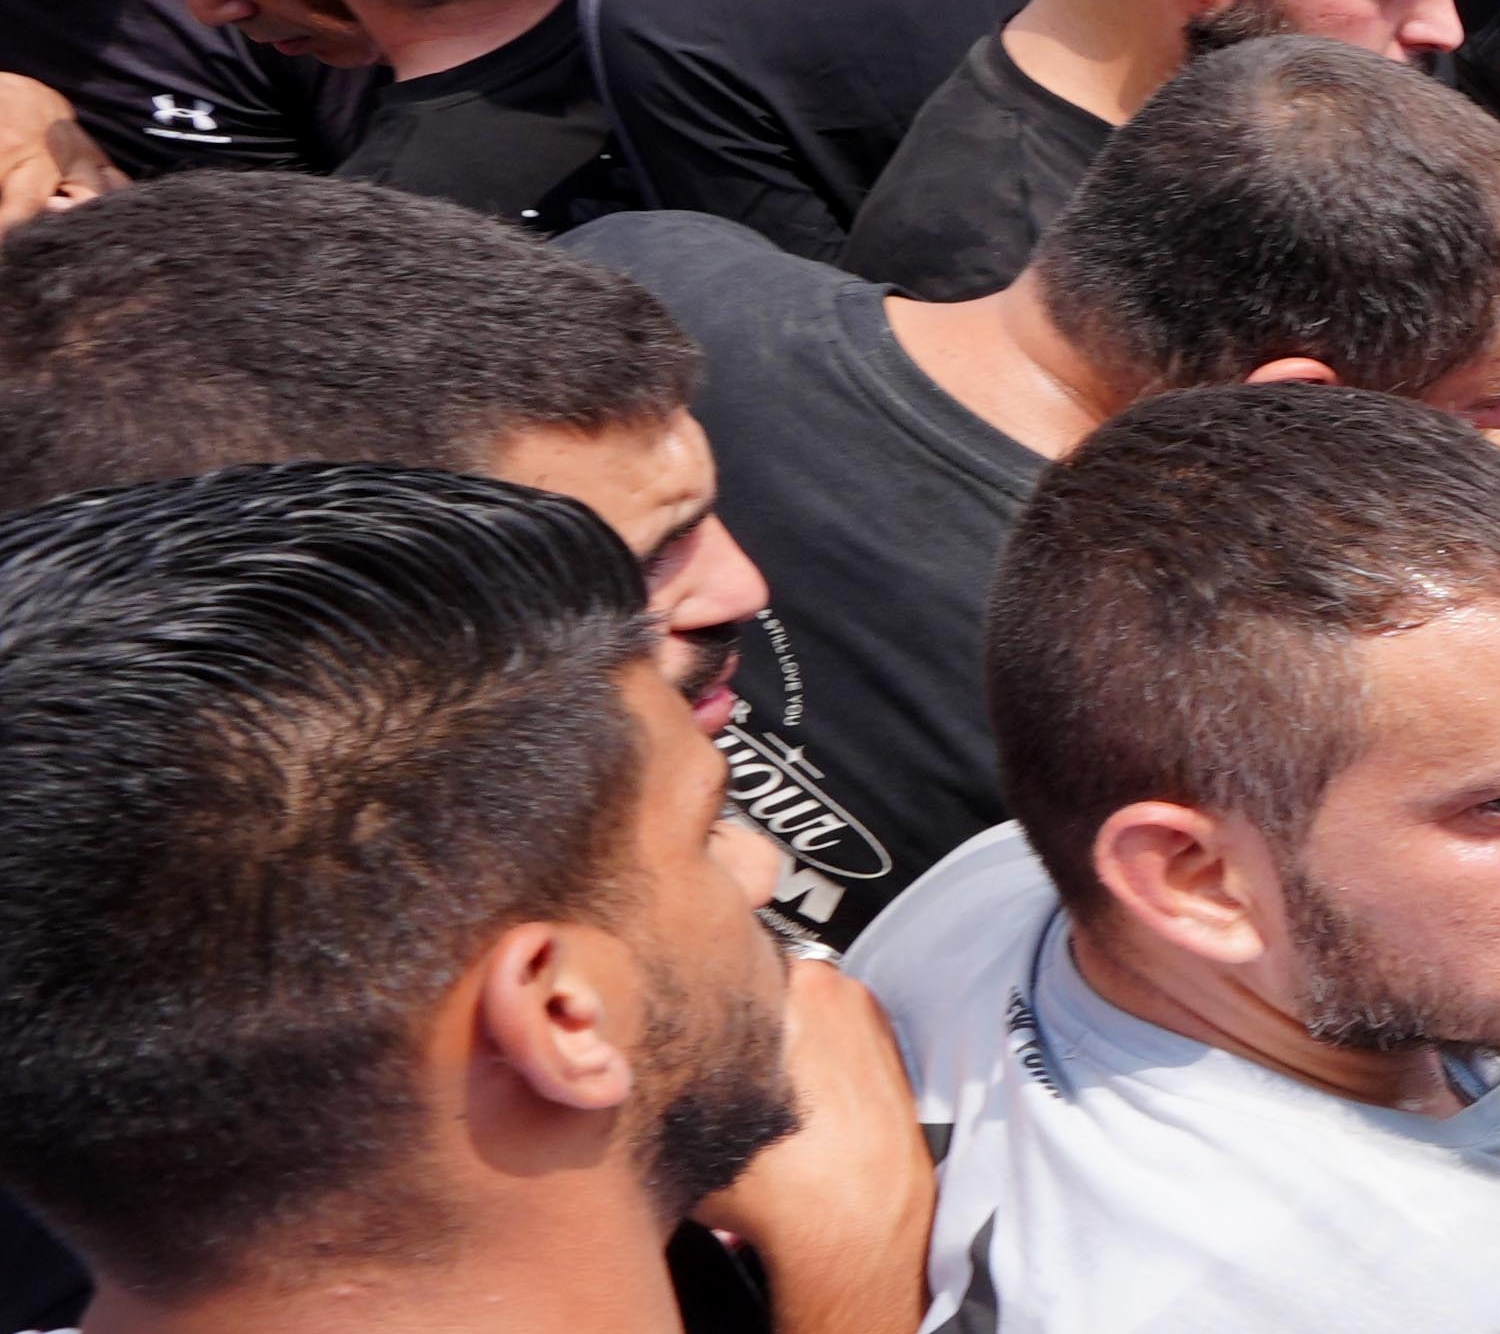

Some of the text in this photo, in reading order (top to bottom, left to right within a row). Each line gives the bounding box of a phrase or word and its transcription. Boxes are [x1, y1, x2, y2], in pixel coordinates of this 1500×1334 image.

[763, 616, 792, 658] STILL
[779, 652, 804, 693] LOVE
[782, 692, 804, 728] YOU
